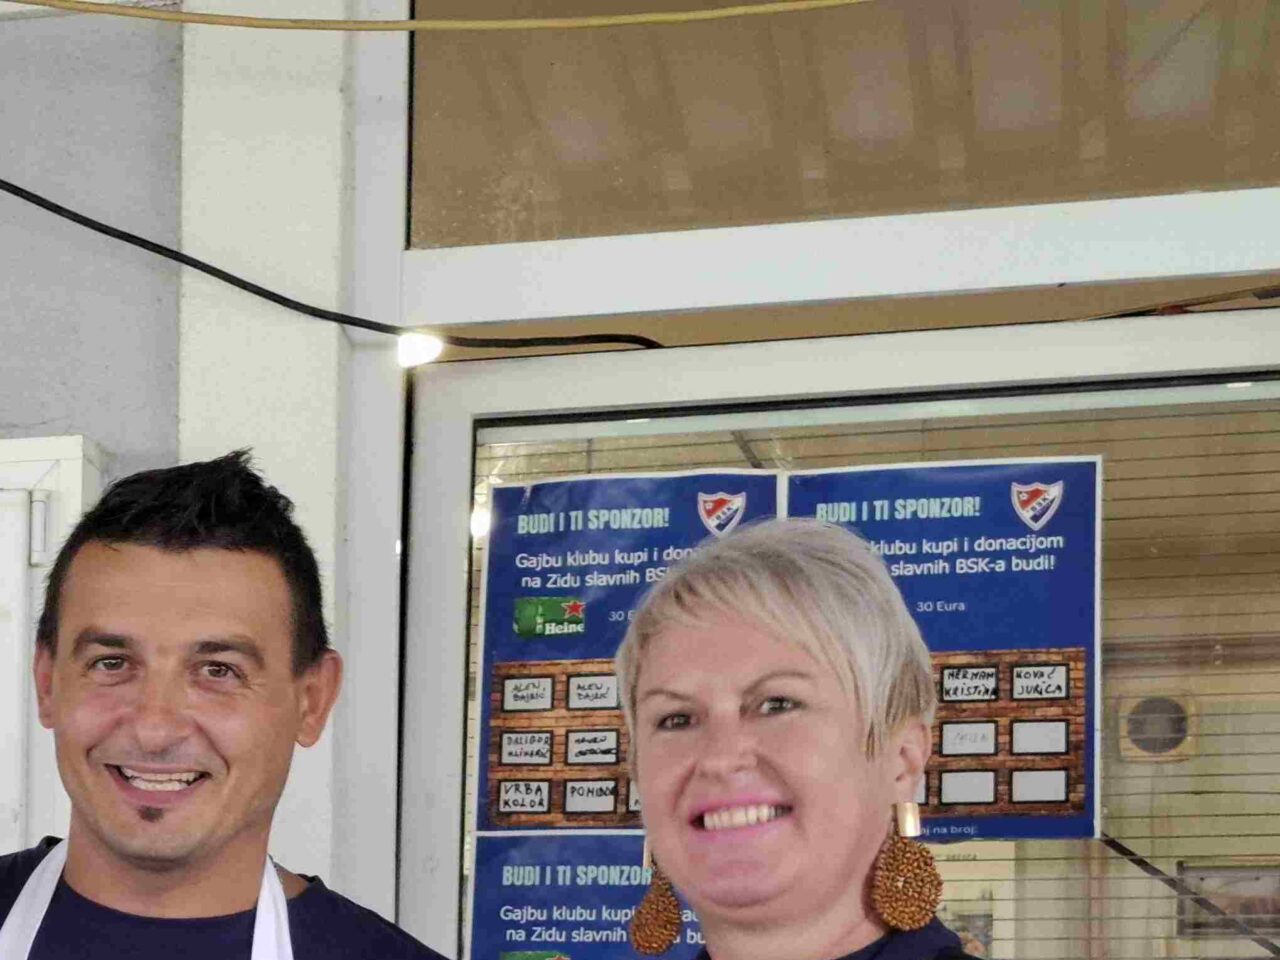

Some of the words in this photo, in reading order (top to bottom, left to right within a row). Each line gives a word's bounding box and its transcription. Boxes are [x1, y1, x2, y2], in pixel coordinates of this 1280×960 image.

[816, 502, 856, 522] BUDI
[862, 501, 868, 521] I
[873, 500, 889, 520] TI
[894, 496, 981, 519] SPONZOR!
[517, 514, 555, 534] BUDI
[559, 513, 565, 531] I
[570, 511, 583, 530] TI
[587, 507, 670, 529] SPONZOR!
[922, 538, 958, 557] kupi
[963, 536, 969, 552] i
[974, 534, 1064, 553] donacijom
[515, 552, 562, 571] Gajbu
[566, 550, 609, 566] klubu
[614, 547, 649, 567] kupi
[653, 547, 659, 561] i
[890, 560, 949, 577] slavnih
[956, 558, 1005, 575] BSK-a
[1012, 556, 1055, 572] budi!
[521, 575, 541, 589] na
[546, 571, 581, 588] Zidu
[585, 570, 640, 587] slavnih
[916, 601, 934, 612] 30
[936, 600, 965, 612] Eura
[608, 611, 625, 622] 30
[502, 866, 540, 886] BUDI
[545, 866, 551, 886] I
[557, 866, 570, 886] TI
[500, 905, 547, 923] Gajbu
[553, 906, 596, 921] klubu
[506, 930, 526, 942] na
[531, 927, 566, 942] Zidu
[572, 927, 627, 942] slavnih
